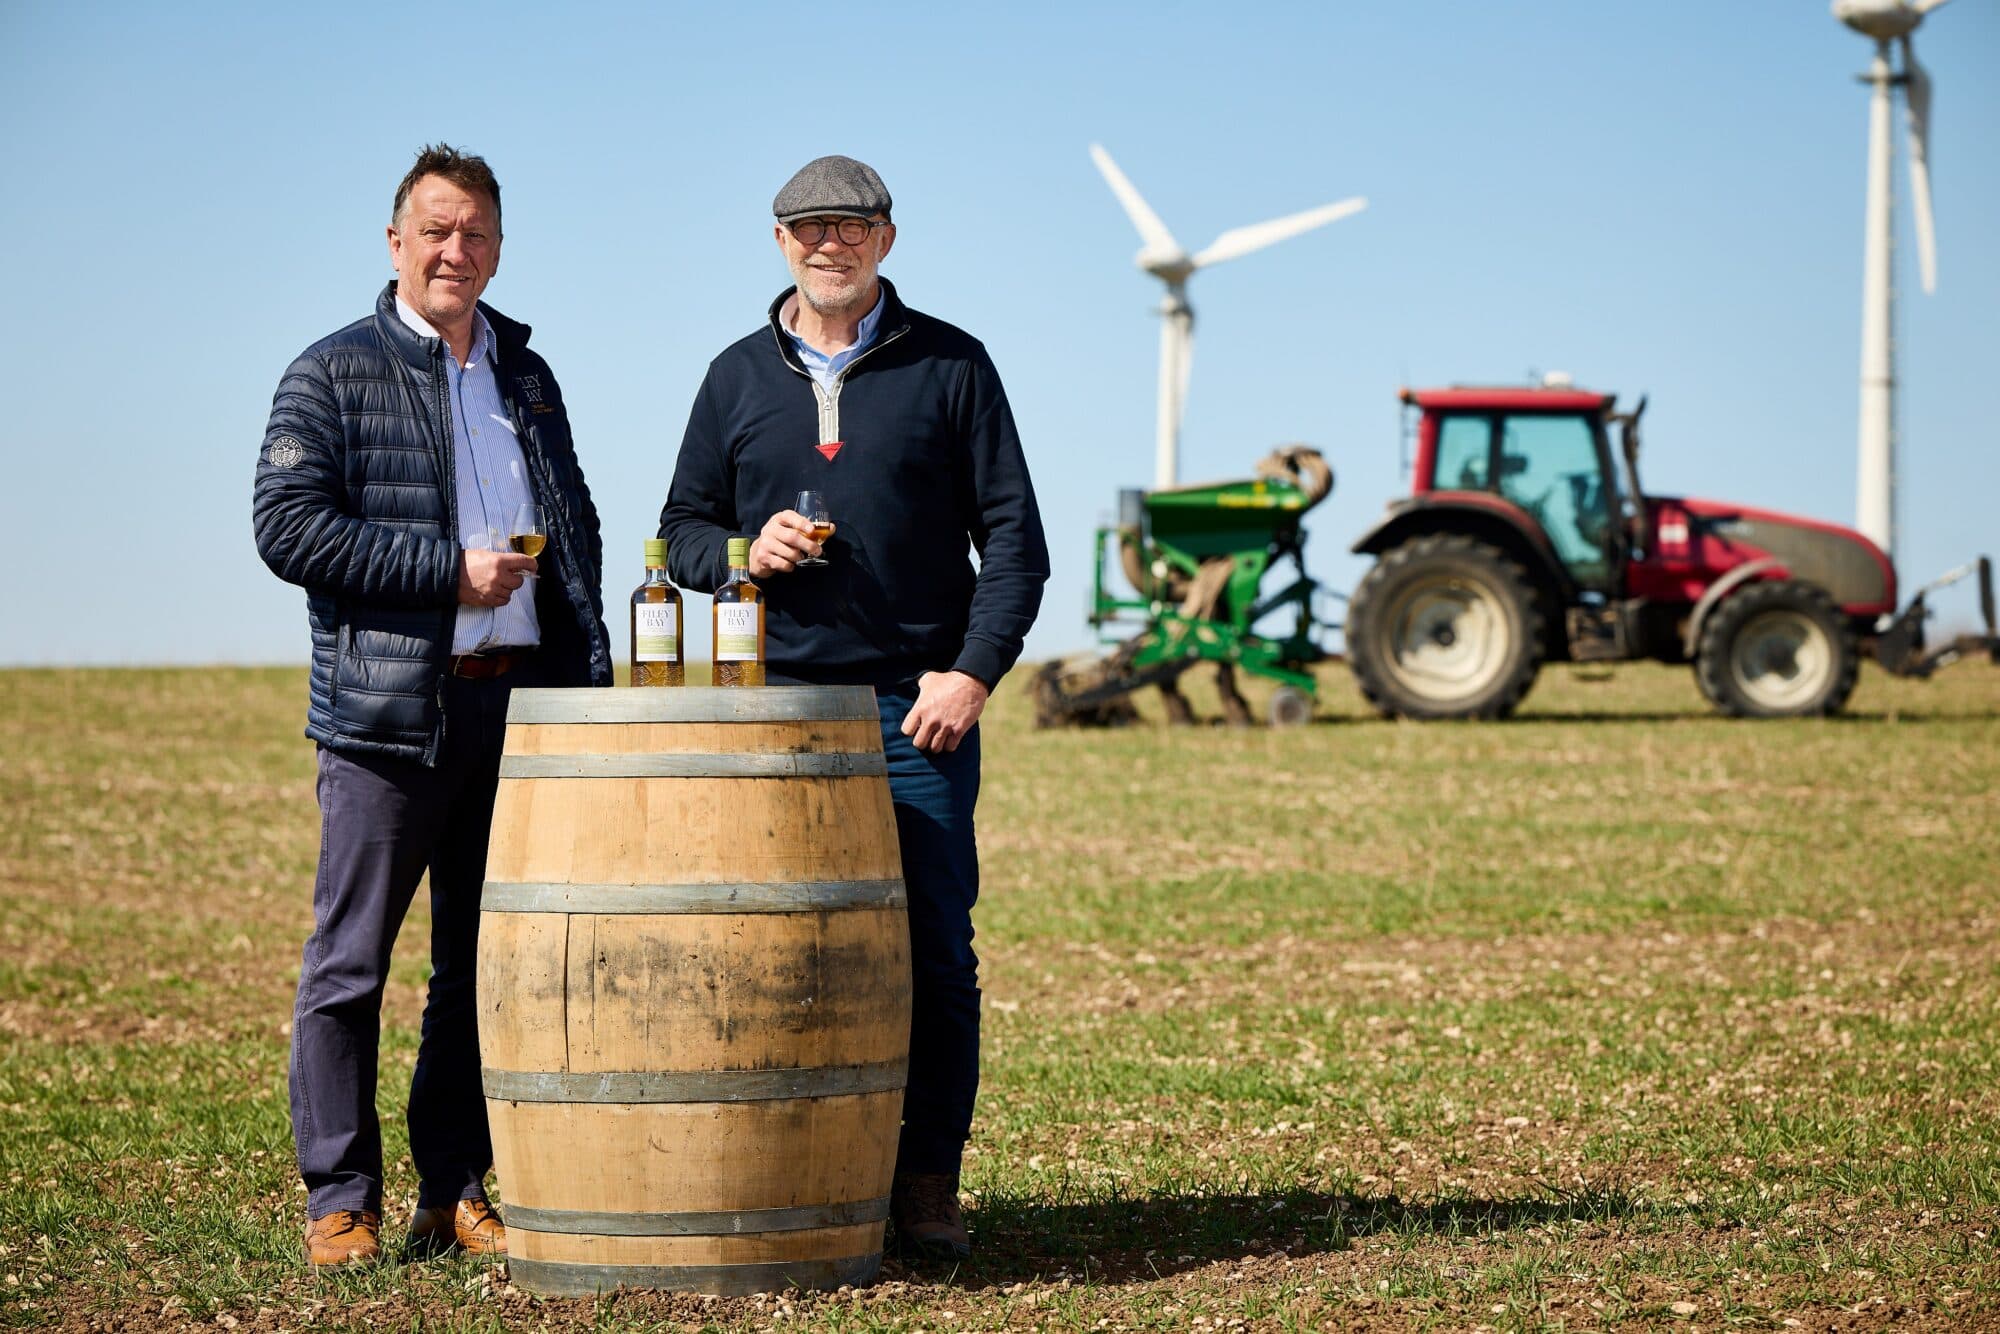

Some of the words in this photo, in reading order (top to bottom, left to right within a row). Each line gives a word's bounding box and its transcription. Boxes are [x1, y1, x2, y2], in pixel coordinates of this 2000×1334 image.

[642, 609, 670, 618] FILEY
[723, 609, 751, 617] FILEY
[646, 618, 665, 626] BAY
[728, 618, 746, 626] BAY
